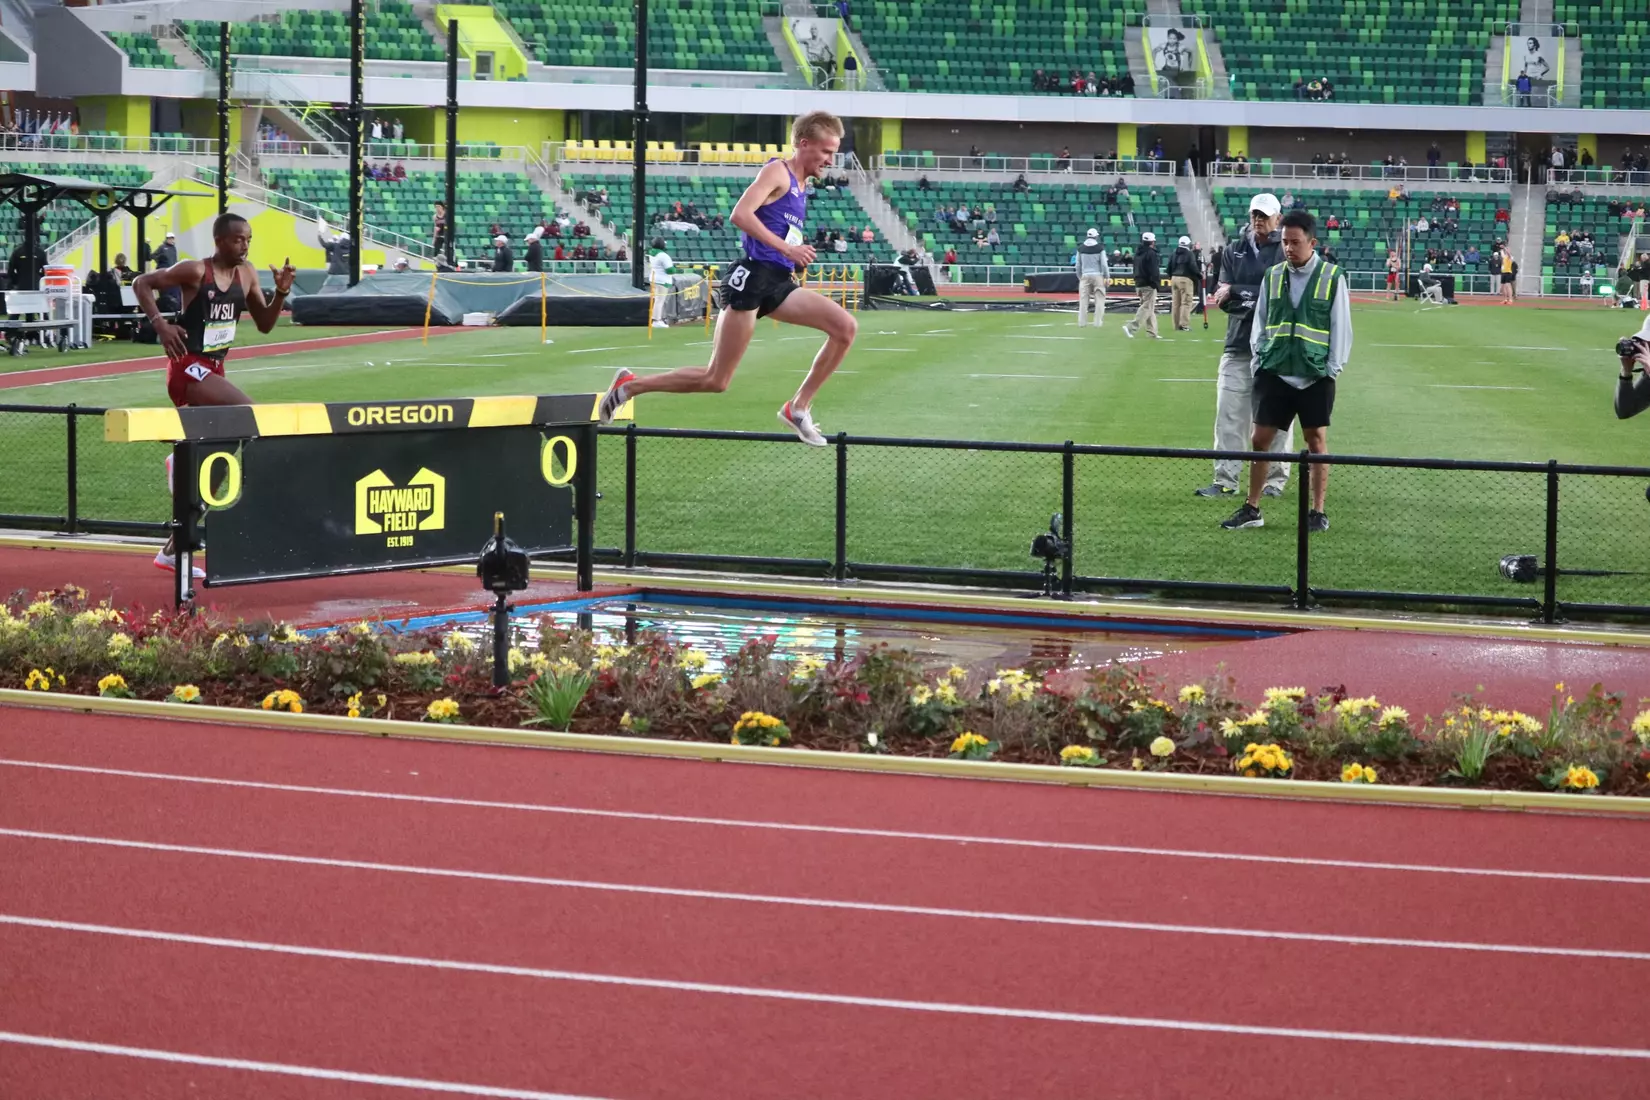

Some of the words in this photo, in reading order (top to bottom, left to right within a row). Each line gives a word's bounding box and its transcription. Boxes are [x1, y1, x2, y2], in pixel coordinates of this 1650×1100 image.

[732, 269, 746, 288] 3
[210, 302, 235, 320] WSU
[189, 366, 208, 379] 2
[347, 404, 454, 426] OREGON
[369, 487, 432, 514] HAYWARD
[384, 511, 417, 532] FIELD
[400, 535, 414, 547] 1919
